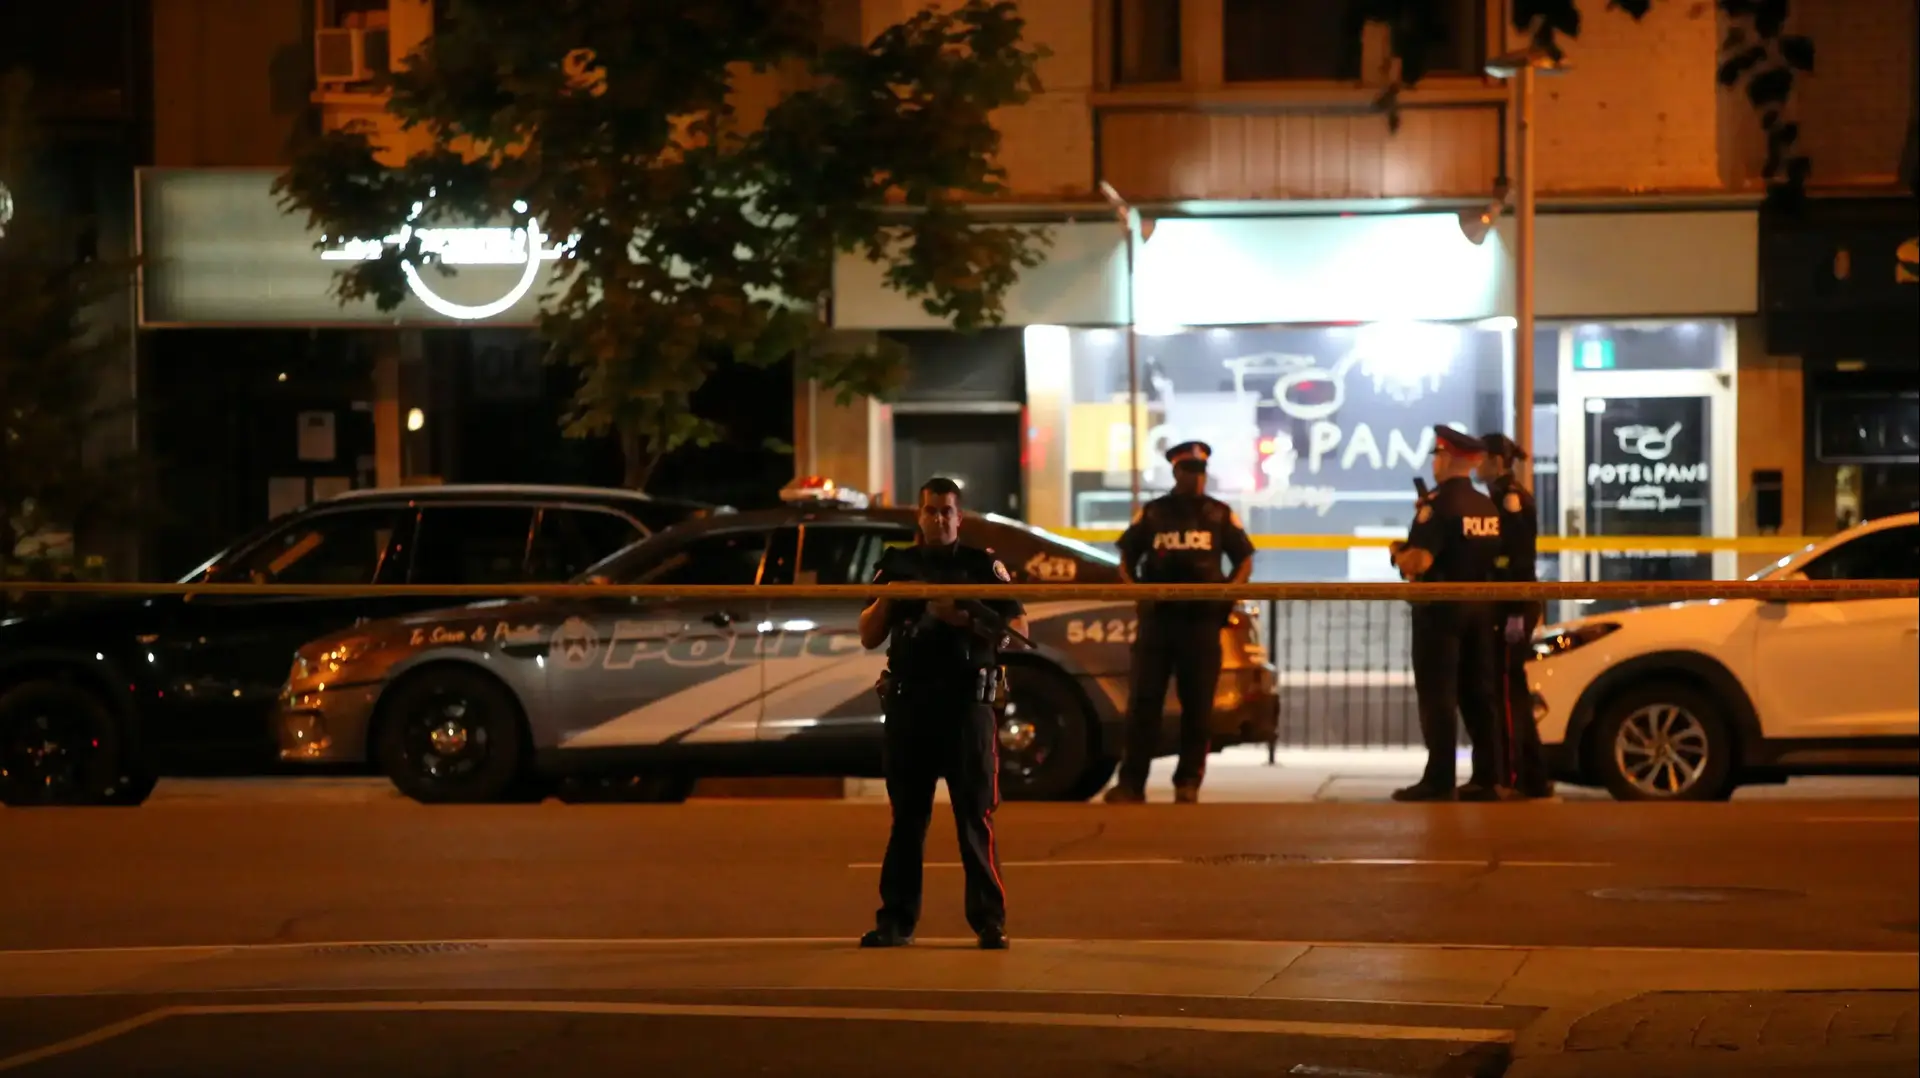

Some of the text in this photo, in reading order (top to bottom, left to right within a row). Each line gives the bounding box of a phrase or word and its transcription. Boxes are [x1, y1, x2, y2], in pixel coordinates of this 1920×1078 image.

[1308, 420, 1468, 474] PAN
[1587, 462, 1641, 485] POTS
[1654, 462, 1708, 485] PANS
[1463, 516, 1500, 536] POLICE
[1153, 531, 1212, 551] POLICE
[602, 620, 886, 669] POLIC
